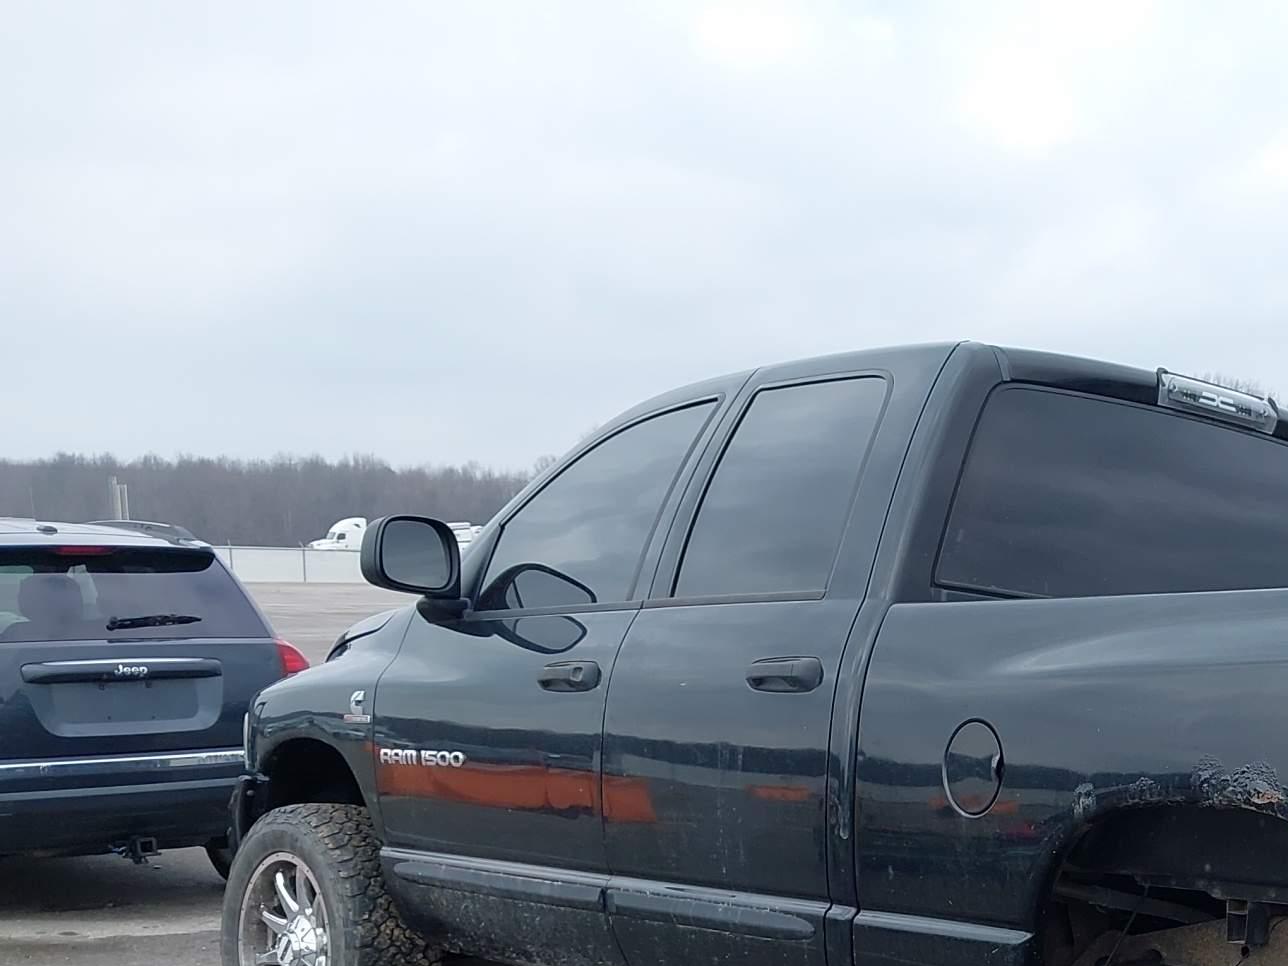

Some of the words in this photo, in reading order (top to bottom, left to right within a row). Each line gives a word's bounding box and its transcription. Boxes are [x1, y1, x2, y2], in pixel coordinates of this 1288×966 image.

[114, 664, 148, 678] Jeep
[380, 748, 417, 765] RAM
[420, 749, 465, 768] 1500
